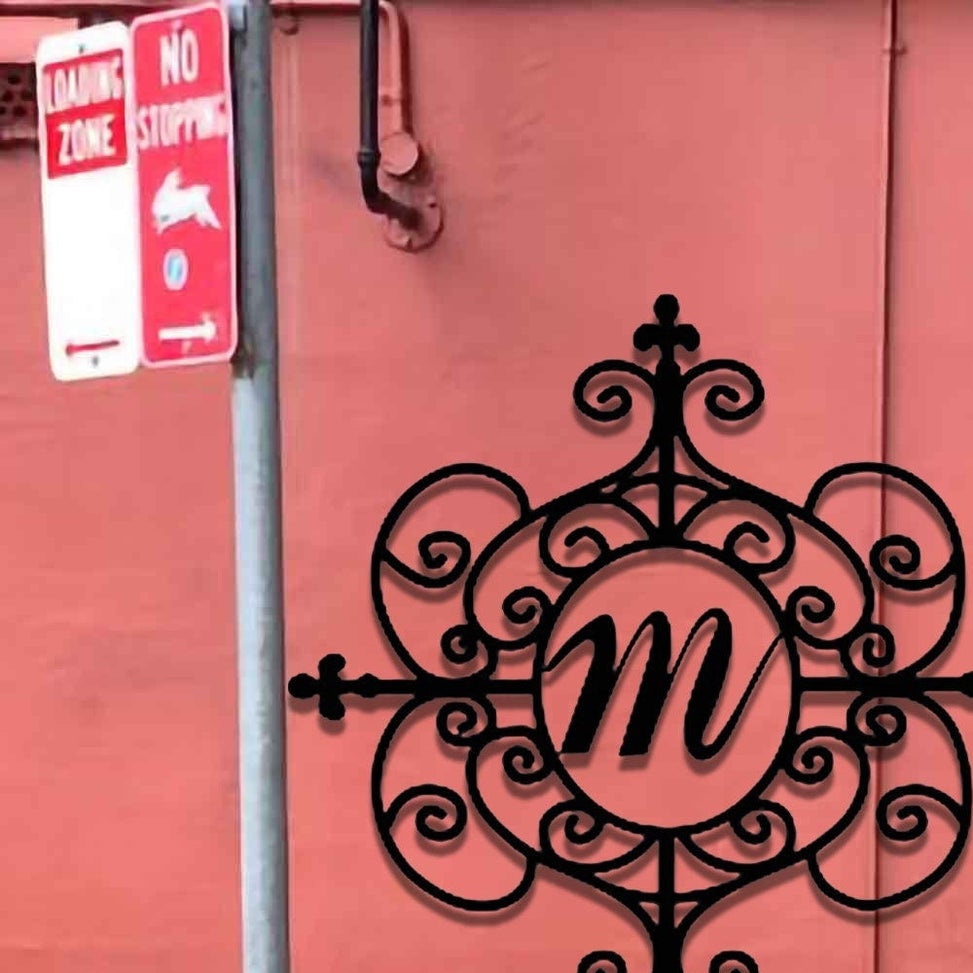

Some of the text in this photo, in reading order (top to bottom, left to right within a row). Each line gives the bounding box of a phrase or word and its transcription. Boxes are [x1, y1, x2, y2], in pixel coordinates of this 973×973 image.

[45, 57, 122, 113] LOADING
[160, 29, 199, 86] NO
[58, 113, 116, 166] ZONE
[137, 94, 228, 150] STOPPING
